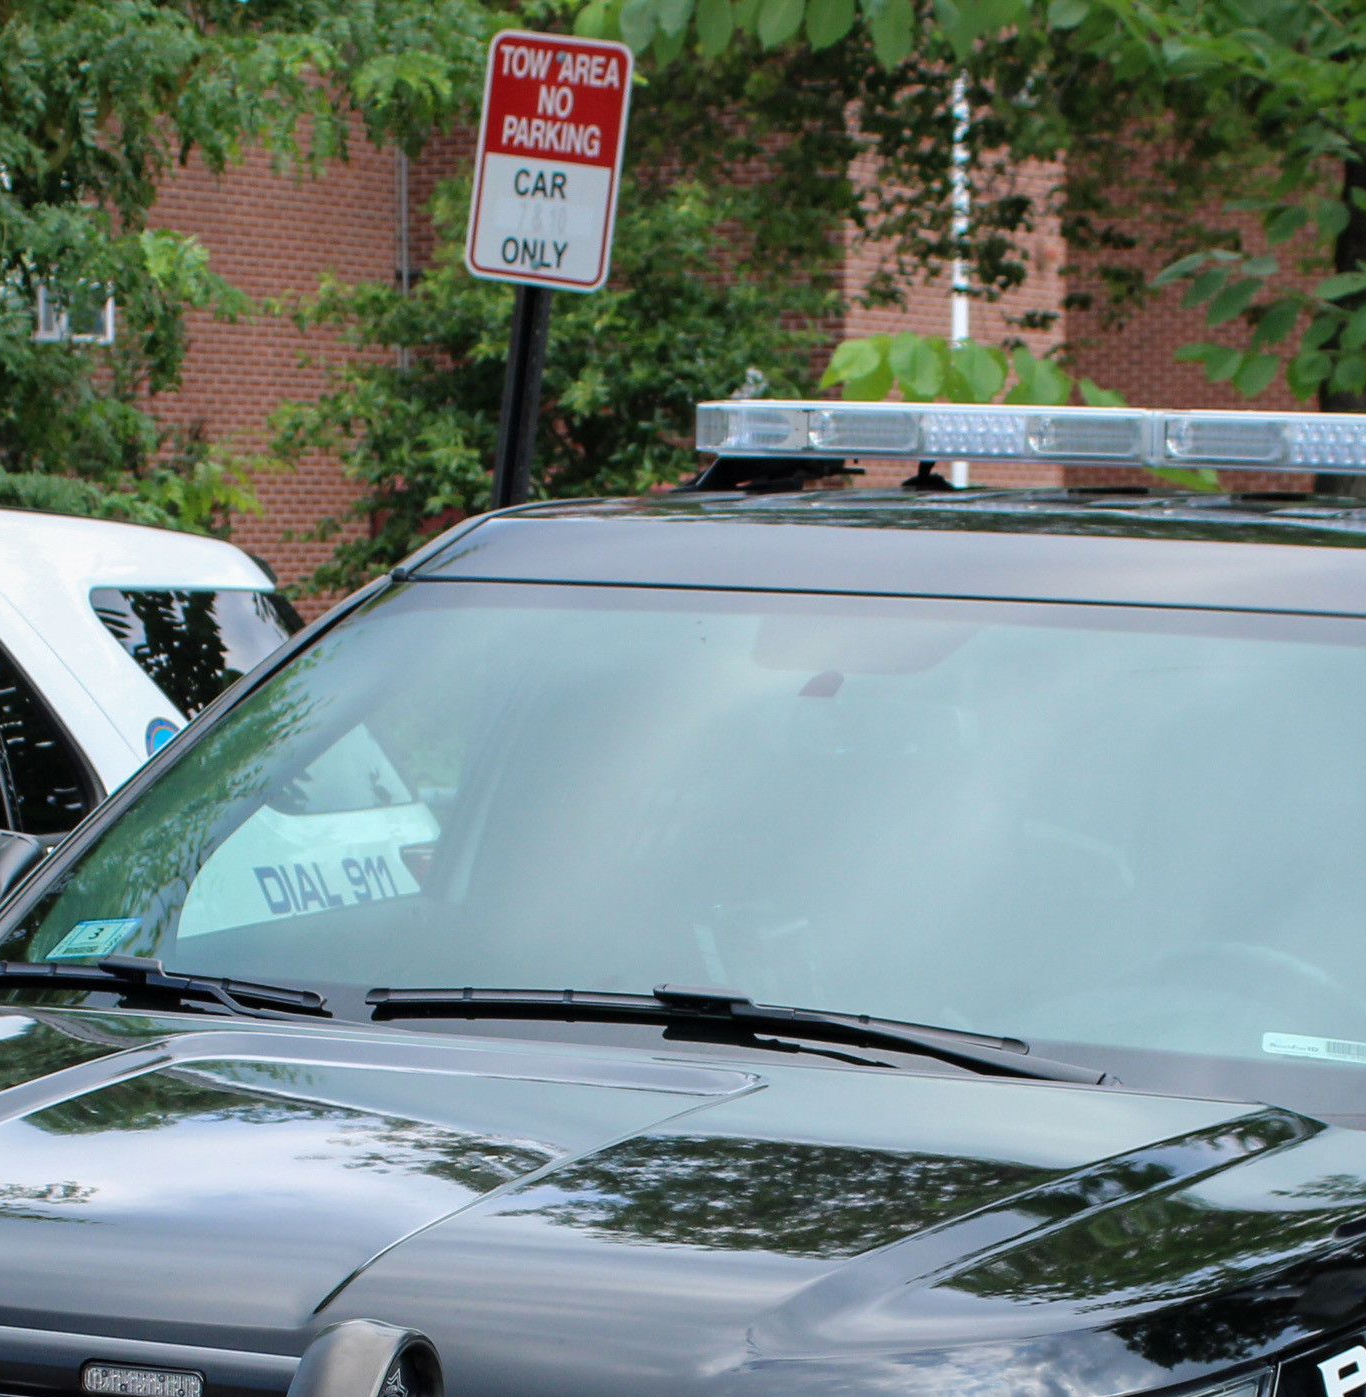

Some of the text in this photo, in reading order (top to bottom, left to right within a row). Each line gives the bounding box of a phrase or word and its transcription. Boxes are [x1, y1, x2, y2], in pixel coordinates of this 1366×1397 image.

[500, 45, 620, 90] TOW AREA
[537, 85, 574, 118] NO
[502, 115, 601, 156] PARKING
[514, 169, 567, 199] CAR
[502, 237, 568, 269] ONLY
[253, 855, 399, 914] DIAL 911
